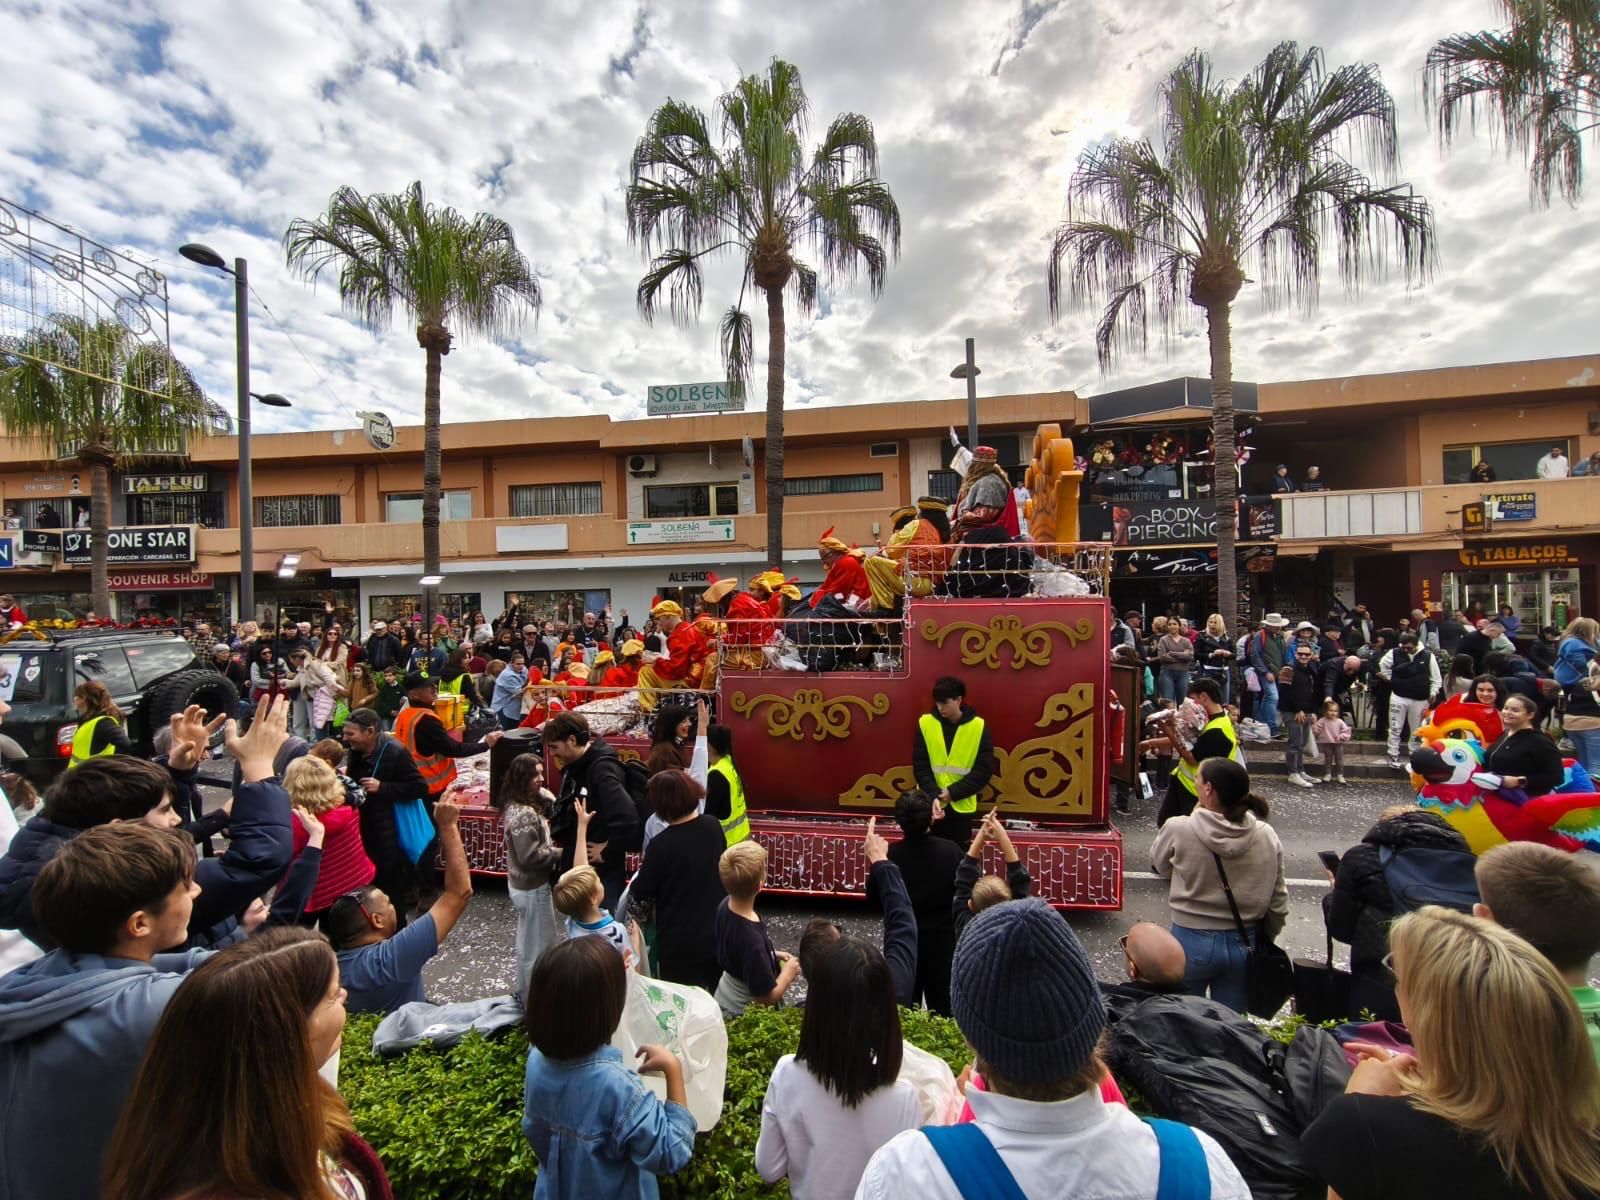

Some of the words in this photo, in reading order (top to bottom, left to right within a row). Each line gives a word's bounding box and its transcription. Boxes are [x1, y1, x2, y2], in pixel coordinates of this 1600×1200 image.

[651, 384, 729, 403] SOLBEN
[1151, 506, 1200, 523] BODY
[85, 532, 143, 549] PONE
[147, 531, 187, 548] STAR
[1127, 551, 1140, 562] A
[1481, 544, 1569, 561] TABACOS
[106, 574, 170, 586] SOUVENIR
[173, 573, 209, 584] SHOP
[668, 571, 709, 583] ALE-HO
